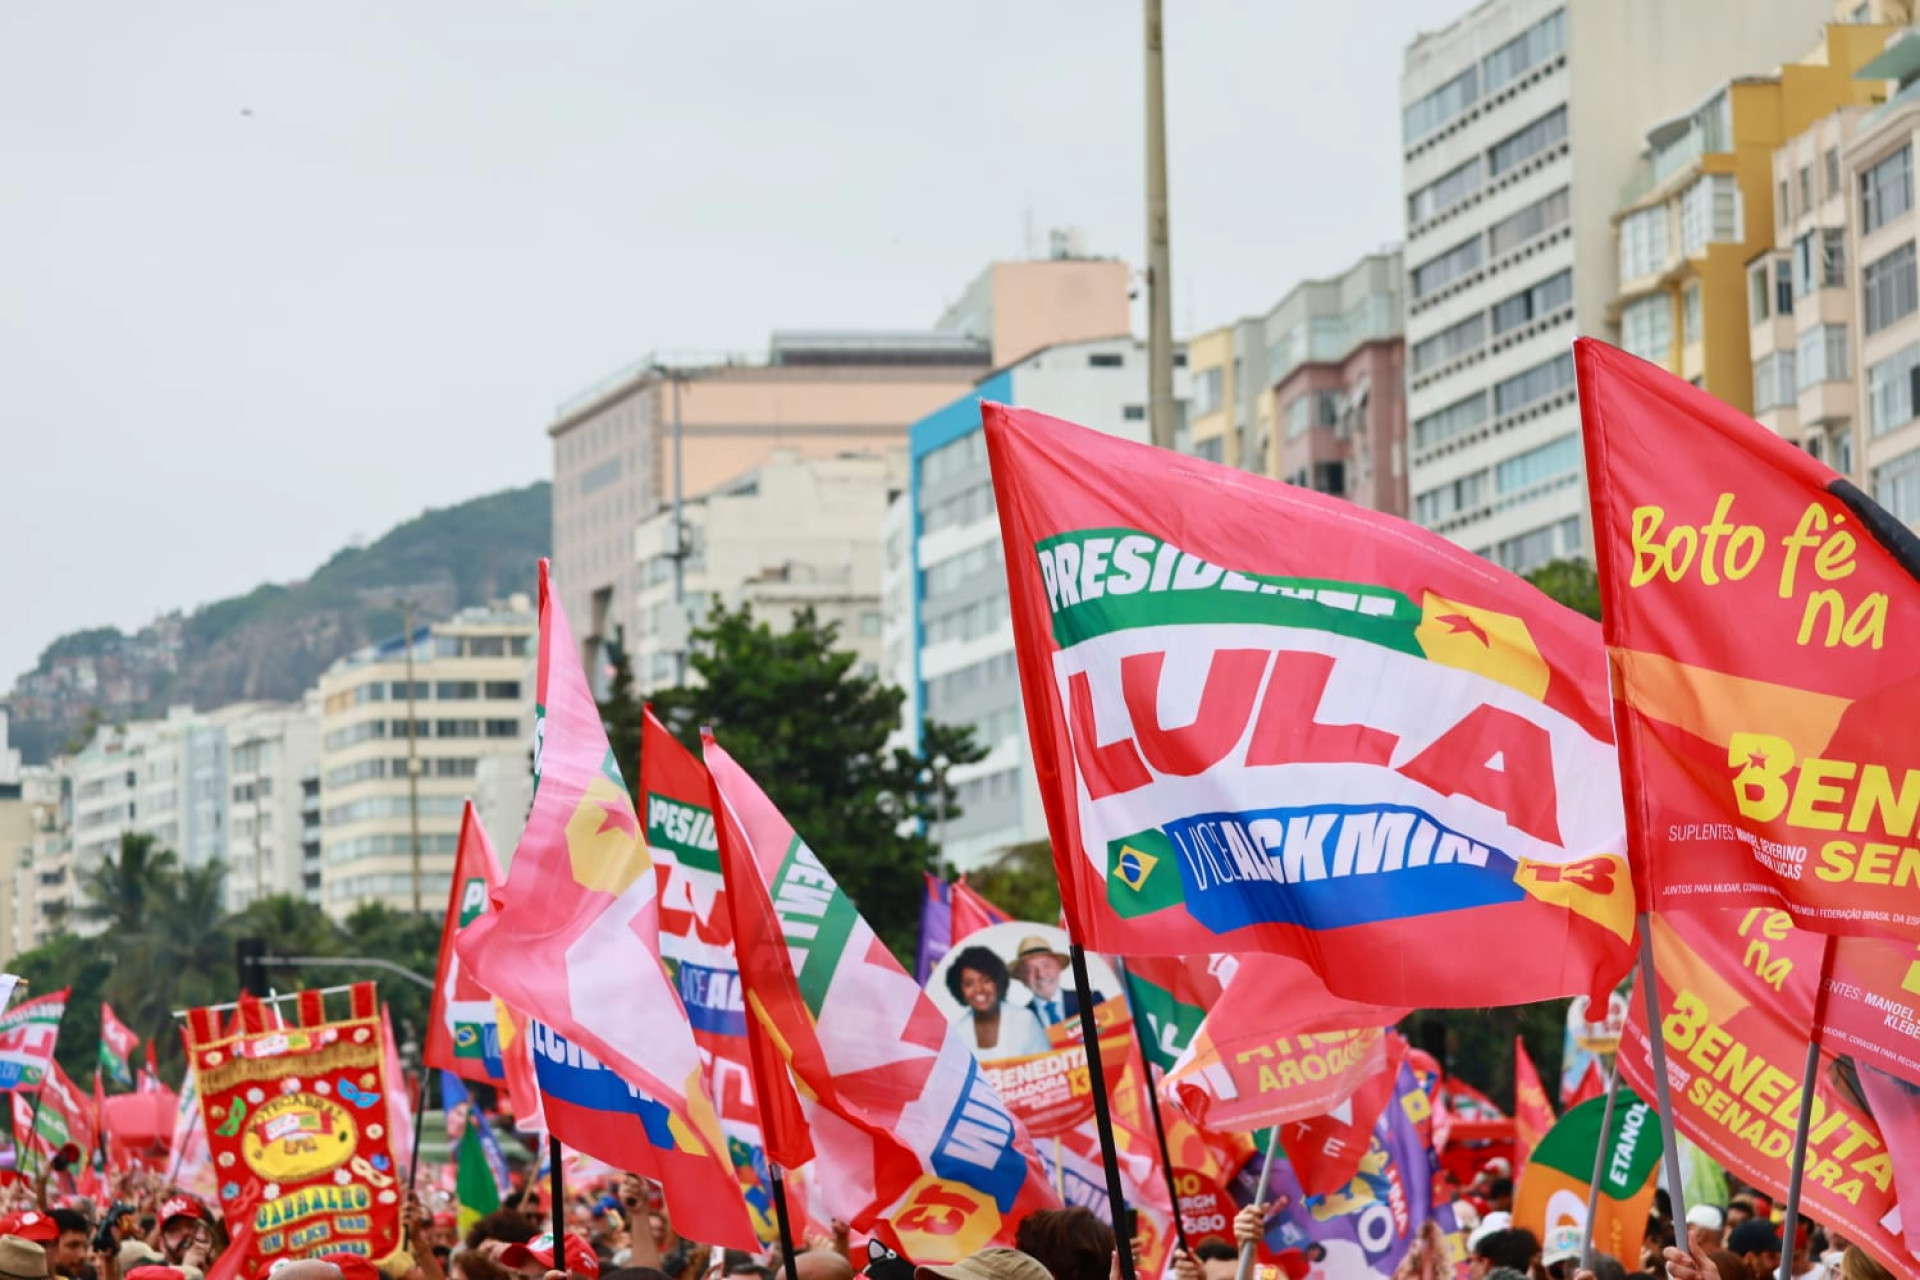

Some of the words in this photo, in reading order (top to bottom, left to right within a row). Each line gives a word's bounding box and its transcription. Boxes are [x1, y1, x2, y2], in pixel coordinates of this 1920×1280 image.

[1630, 493, 1765, 587] Boto
[1779, 502, 1857, 598] fé
[1797, 588, 1889, 650] na
[1069, 648, 1564, 848] LULA
[1727, 732, 1920, 838] BEN
[1669, 823, 1736, 842] SUPLENTES:
[1743, 938, 1794, 991] na
[1865, 992, 1914, 1021] MANOEL
[1067, 1067, 1092, 1097] 13
[1662, 989, 1894, 1194] BENEDITA
[1610, 1103, 1649, 1187] ETANOL
[1688, 1077, 1865, 1206] SENADORA
